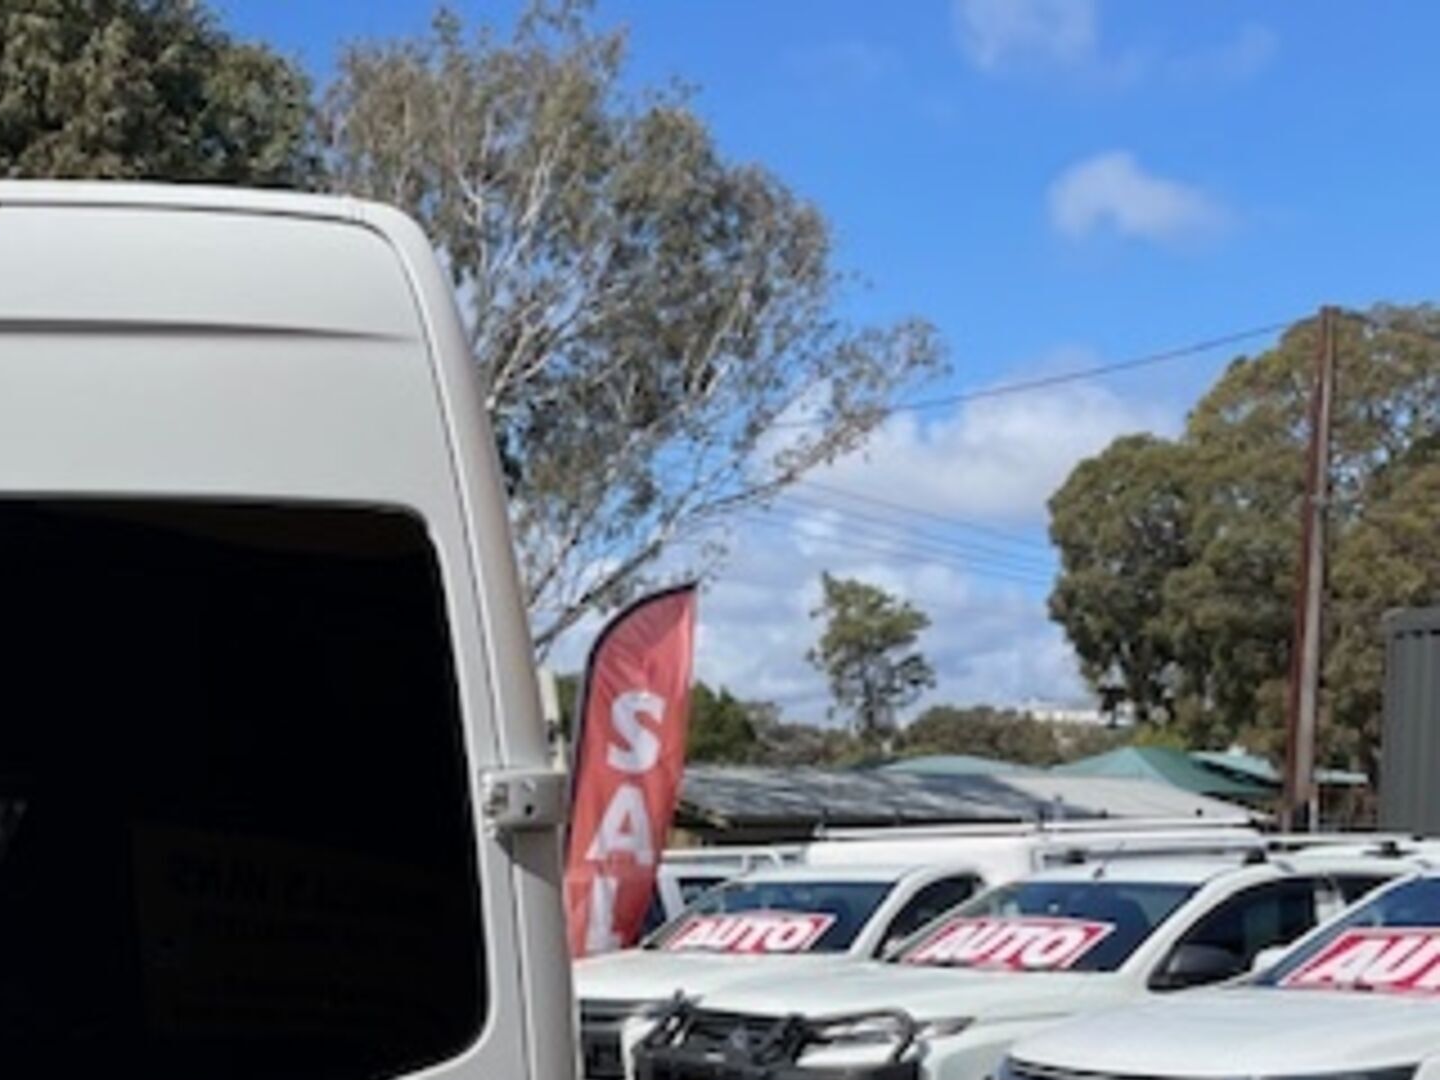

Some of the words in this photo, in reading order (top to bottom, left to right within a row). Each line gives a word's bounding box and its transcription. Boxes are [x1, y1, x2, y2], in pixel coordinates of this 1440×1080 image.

[586, 690, 665, 952] SAL
[670, 915, 810, 951] AUTO
[912, 922, 1084, 967] AUTO
[1292, 936, 1440, 989] AU
